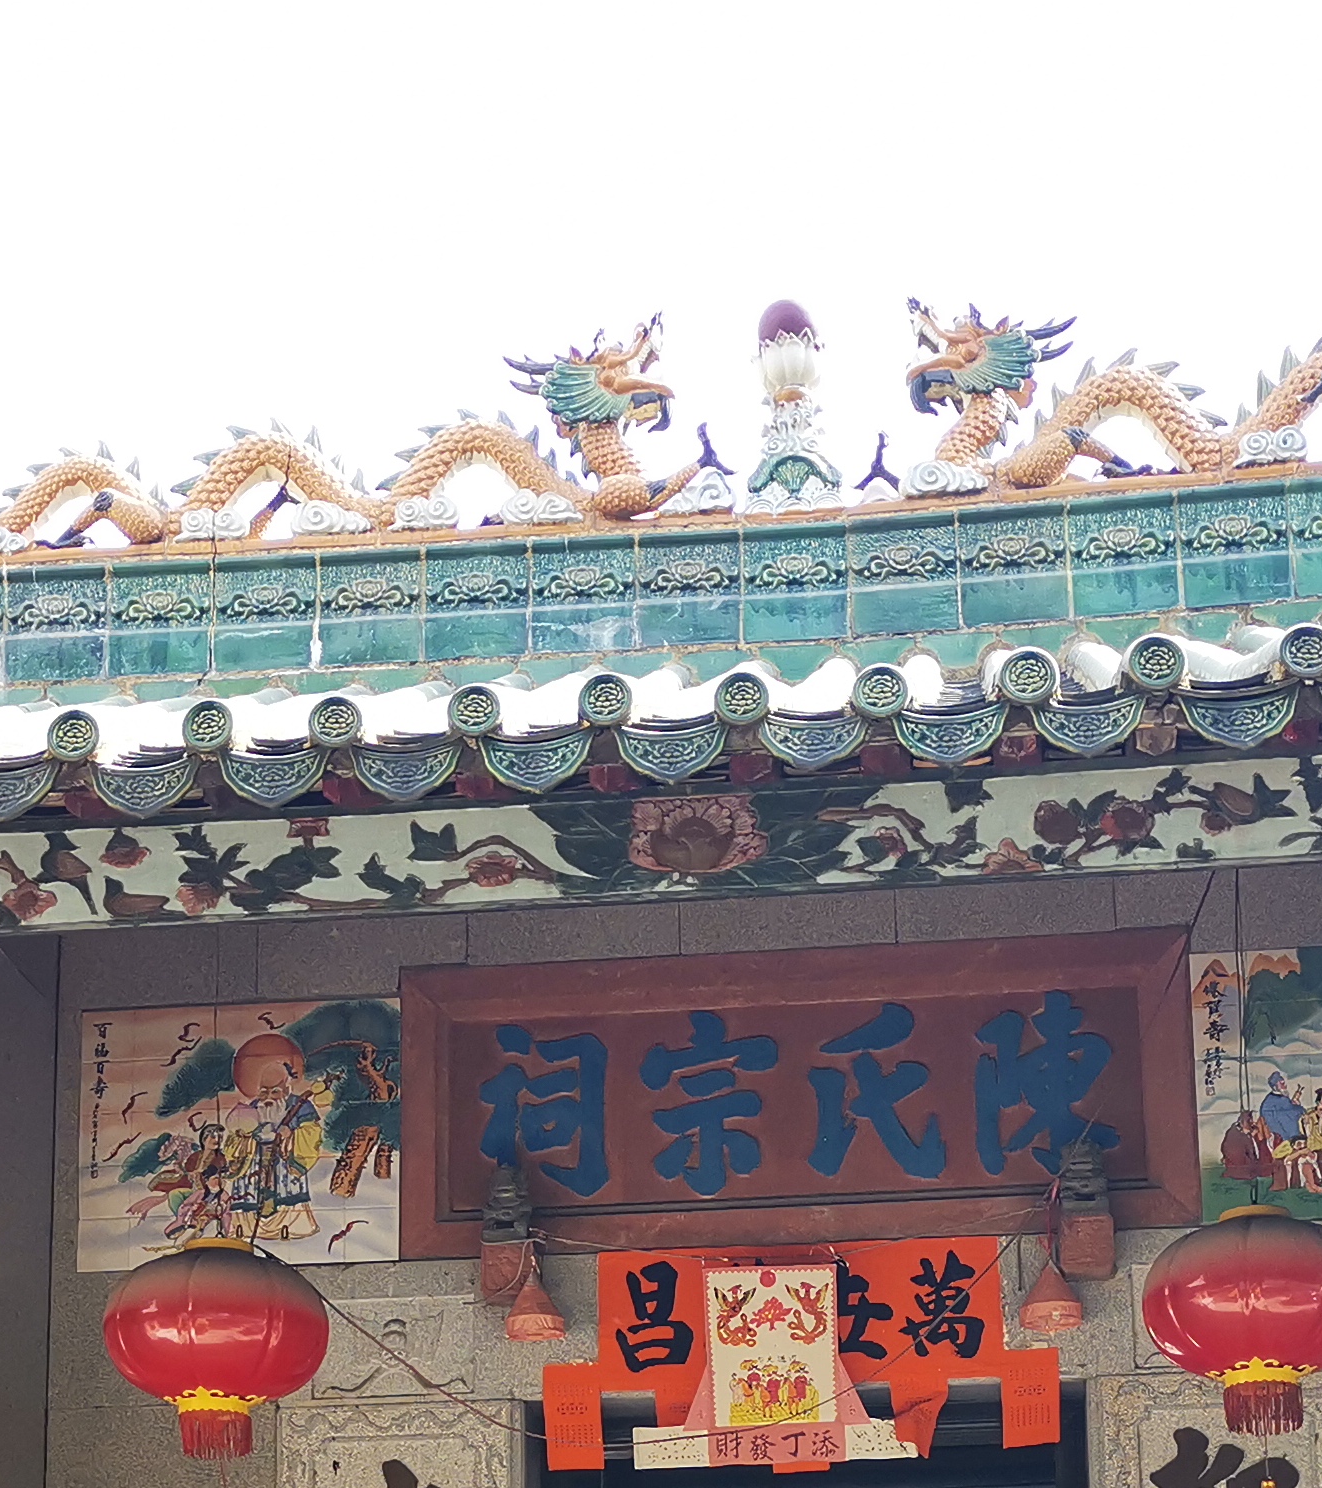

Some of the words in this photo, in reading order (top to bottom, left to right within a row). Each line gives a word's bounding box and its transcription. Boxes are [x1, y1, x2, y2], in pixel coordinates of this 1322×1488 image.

[479, 989, 1120, 1197] 陳氏宗祠
[715, 1430, 841, 1462] 添丁發財
